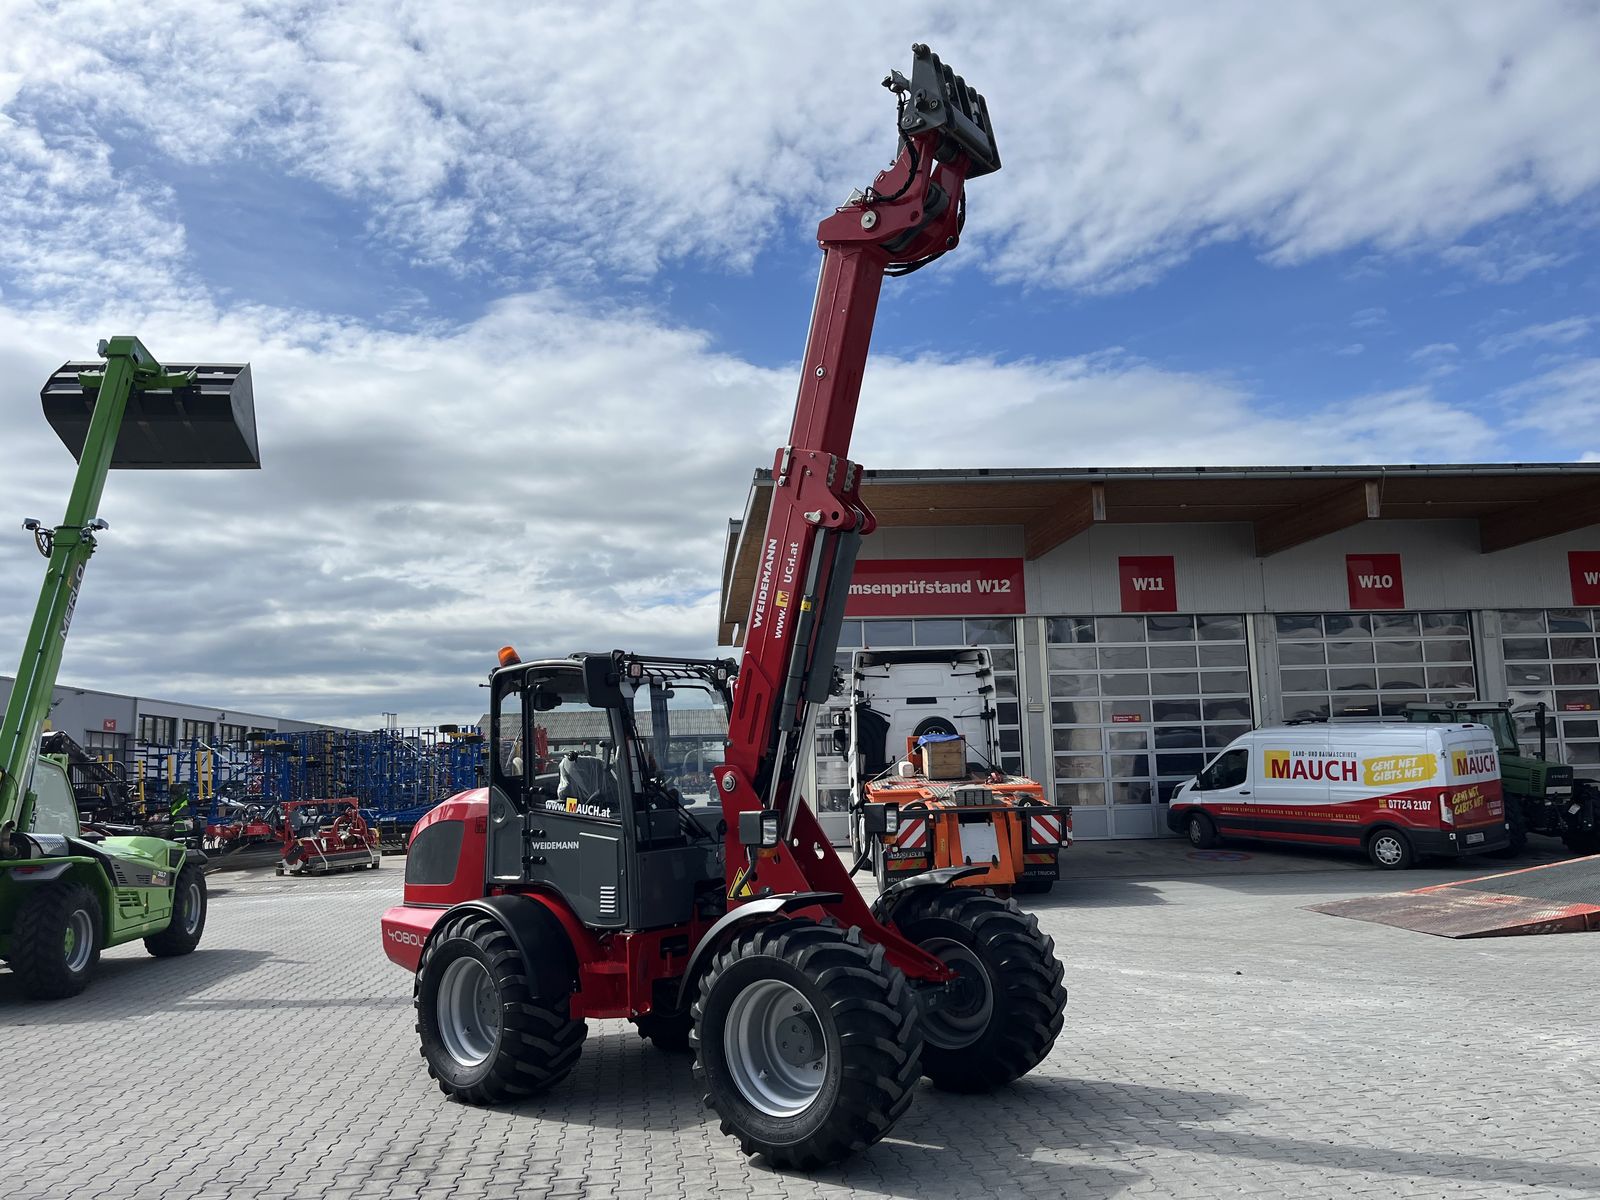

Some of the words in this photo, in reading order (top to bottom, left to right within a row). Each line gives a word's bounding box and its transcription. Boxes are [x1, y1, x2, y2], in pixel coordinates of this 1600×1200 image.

[753, 538, 778, 629] WEIDEMANN
[1132, 577, 1165, 591] W11
[1358, 574, 1393, 589] W10
[1583, 571, 1600, 585] W
[848, 579, 972, 598] msenprüfstand
[976, 579, 1011, 593] W12
[60, 563, 84, 640] MERLO
[1271, 758, 1358, 782] MAUCH
[1371, 759, 1396, 772] GEHT
[1398, 757, 1418, 769] NET
[1457, 754, 1496, 776] MAUCH
[1373, 769, 1403, 782] GIBTS
[1404, 767, 1424, 779] NET
[545, 800, 611, 818] www.MAUCH.at
[1388, 799, 1412, 809] 07724
[1413, 800, 1431, 810] 2107
[532, 841, 580, 850] WEIDEMANN
